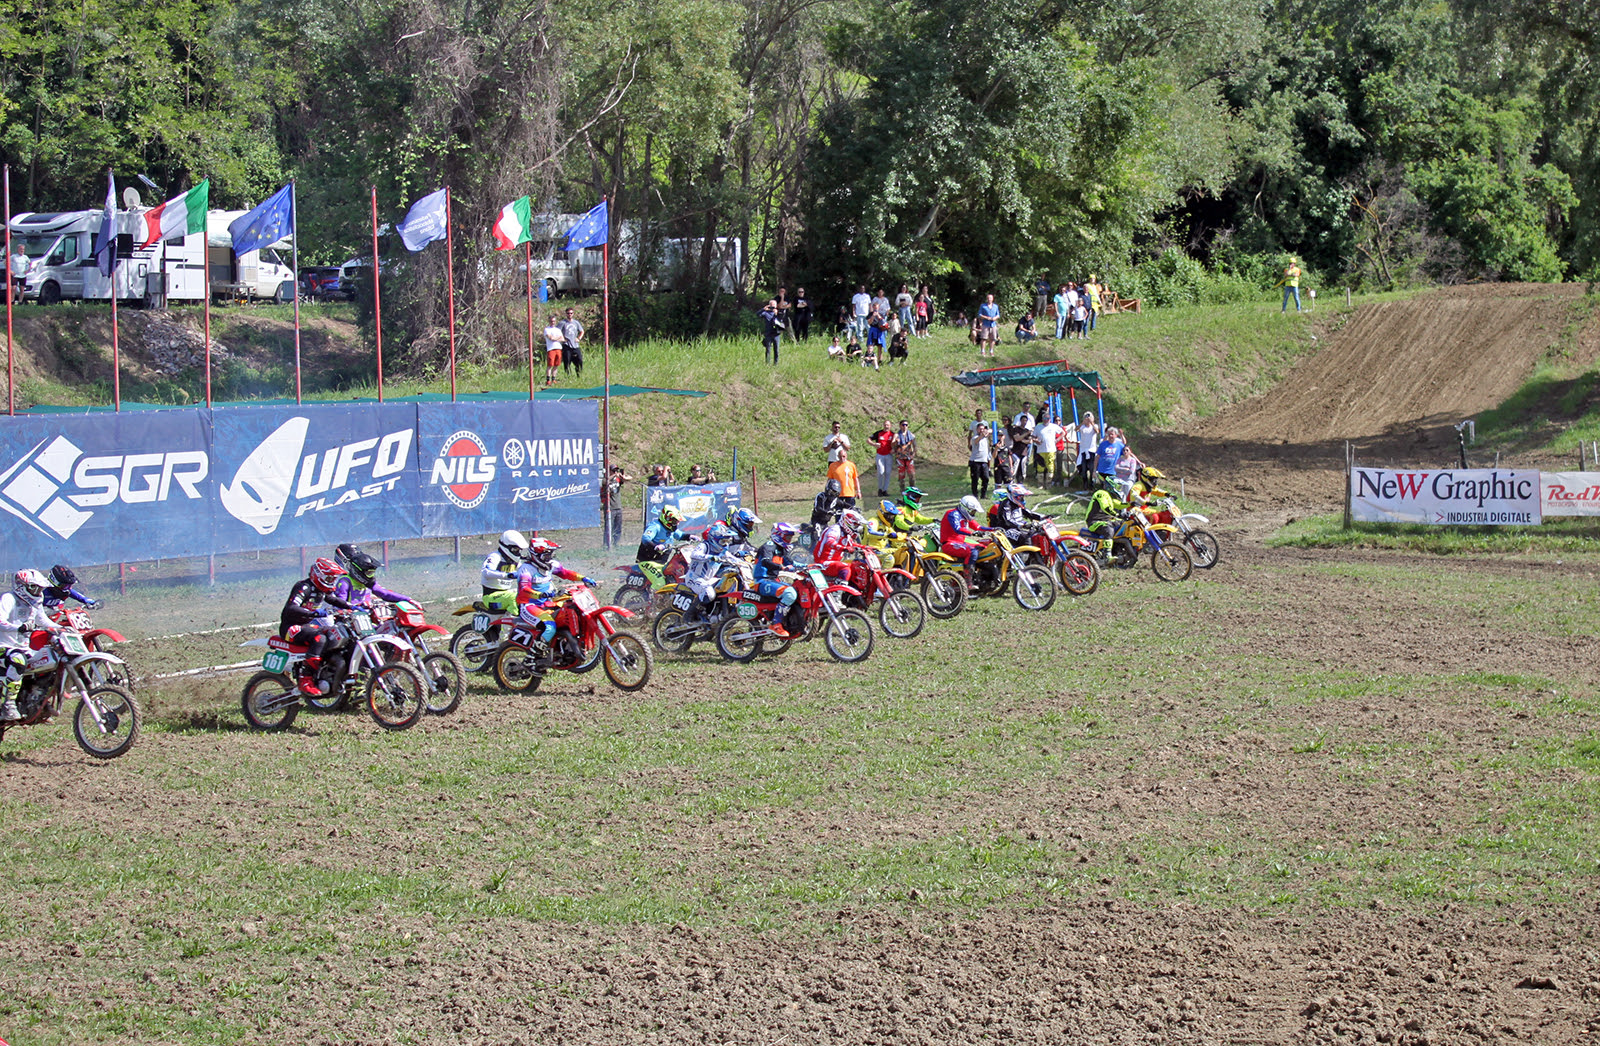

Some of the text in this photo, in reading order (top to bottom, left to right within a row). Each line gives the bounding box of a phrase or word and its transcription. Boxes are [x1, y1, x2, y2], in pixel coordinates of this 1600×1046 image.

[525, 438, 594, 466] YAMAHA
[295, 428, 414, 500] UFO
[430, 455, 498, 485] NILS
[512, 467, 590, 478] RACING
[67, 451, 209, 507] SGR
[294, 476, 401, 518] PLAST
[511, 482, 591, 504] Revs Your Heart
[1356, 470, 1532, 508] NeW Graphic
[1447, 512, 1531, 523] INDUSTRIA DIGITALE
[627, 575, 645, 587] 286
[672, 593, 692, 611] 146
[743, 591, 761, 602] 125R
[739, 605, 756, 616] 350
[355, 614, 373, 631] 161
[473, 616, 489, 631] 184
[270, 639, 290, 649] YAMAHA
[511, 628, 532, 646] 71
[264, 653, 284, 671] 161
